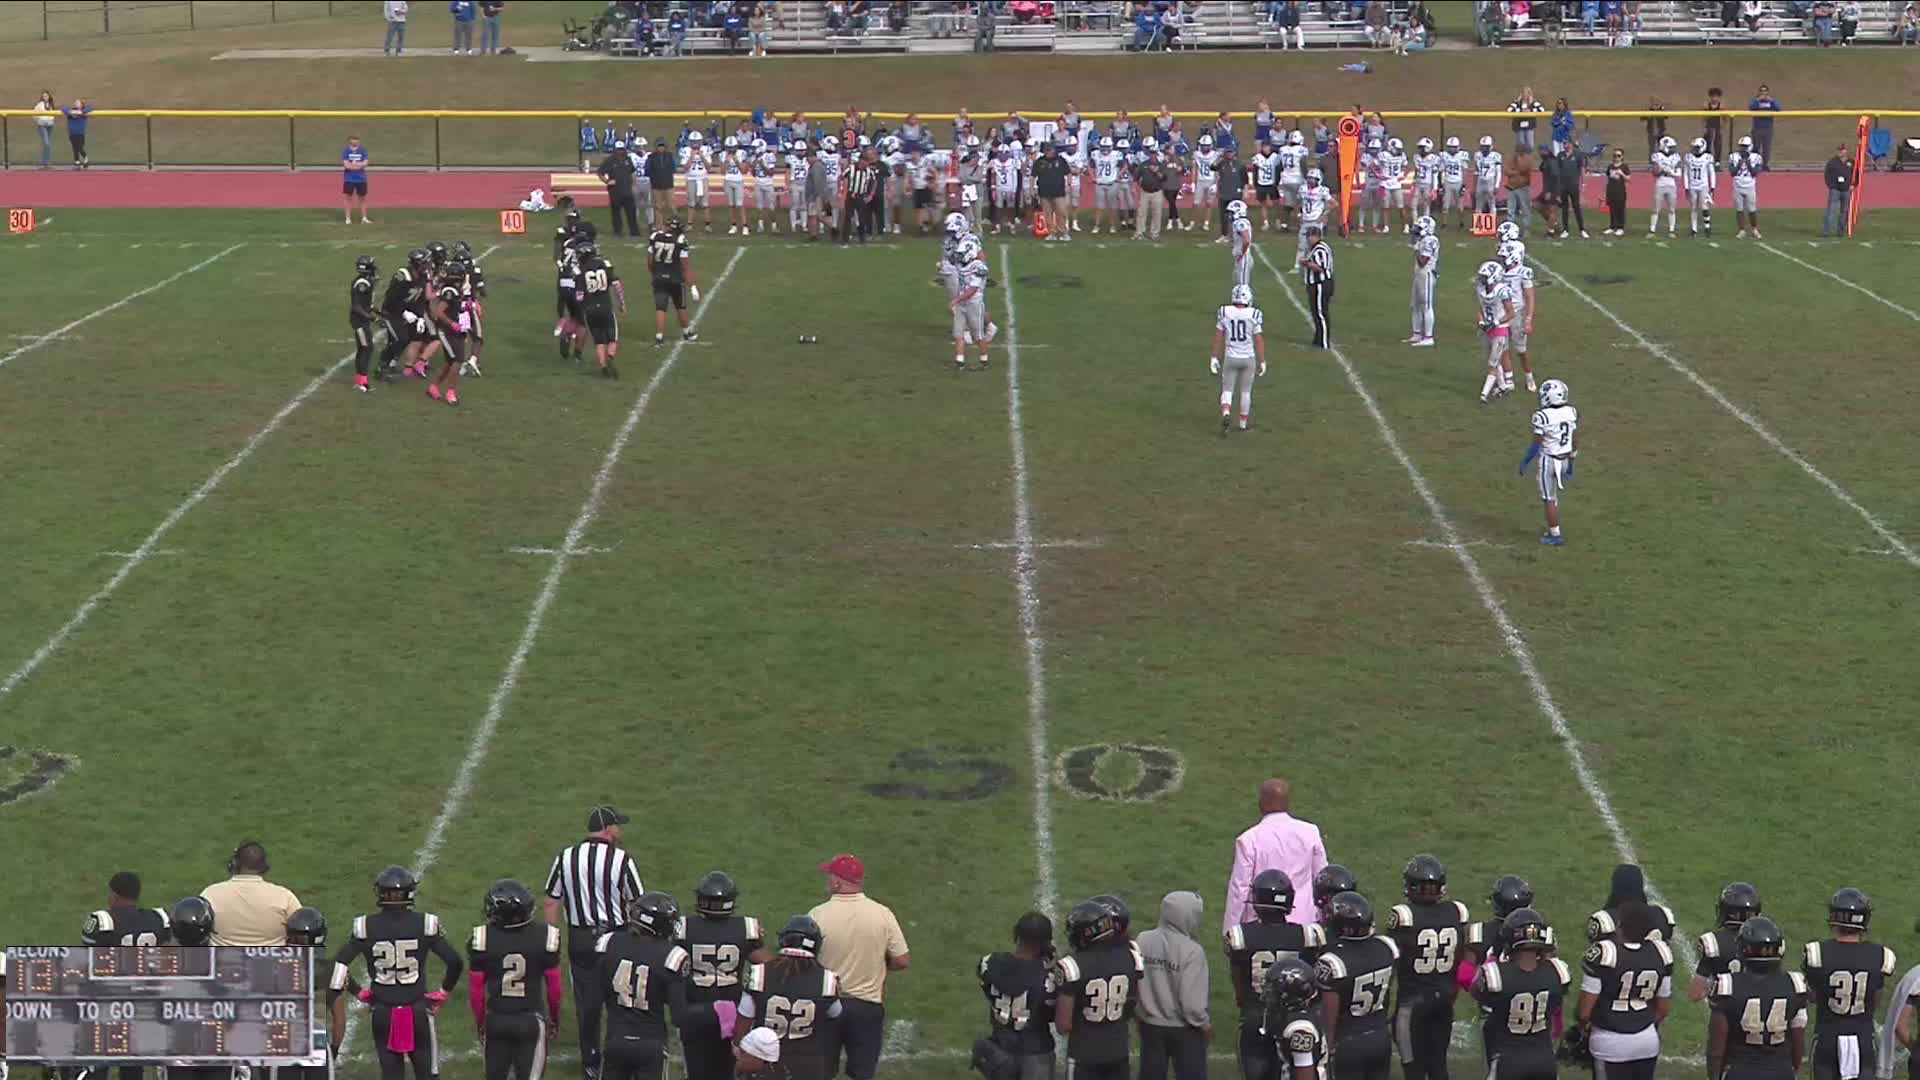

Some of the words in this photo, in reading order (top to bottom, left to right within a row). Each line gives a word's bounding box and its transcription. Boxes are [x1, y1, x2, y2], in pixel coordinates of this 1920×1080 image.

[1001, 172, 1008, 185] 3
[1098, 163, 1111, 176] 78
[11, 211, 29, 228] 30
[503, 212, 522, 229] 40
[1475, 215, 1493, 231] 40
[654, 241, 675, 263] 77
[585, 269, 608, 293] 60
[1230, 319, 1247, 342] 10
[1559, 421, 1569, 446] 2
[372, 938, 419, 985] 25
[692, 944, 740, 988] 52
[1413, 928, 1458, 974] 33
[501, 953, 527, 997] 2
[612, 959, 649, 1010] 41
[1350, 966, 1393, 1017] 57
[1611, 970, 1660, 1012] 13
[1828, 970, 1869, 1016] 31
[765, 995, 816, 1040] 62
[1083, 974, 1129, 1022] 38
[1508, 991, 1549, 1035] 81
[1290, 1032, 1314, 1051] 23
[1741, 998, 1788, 1046] 44
